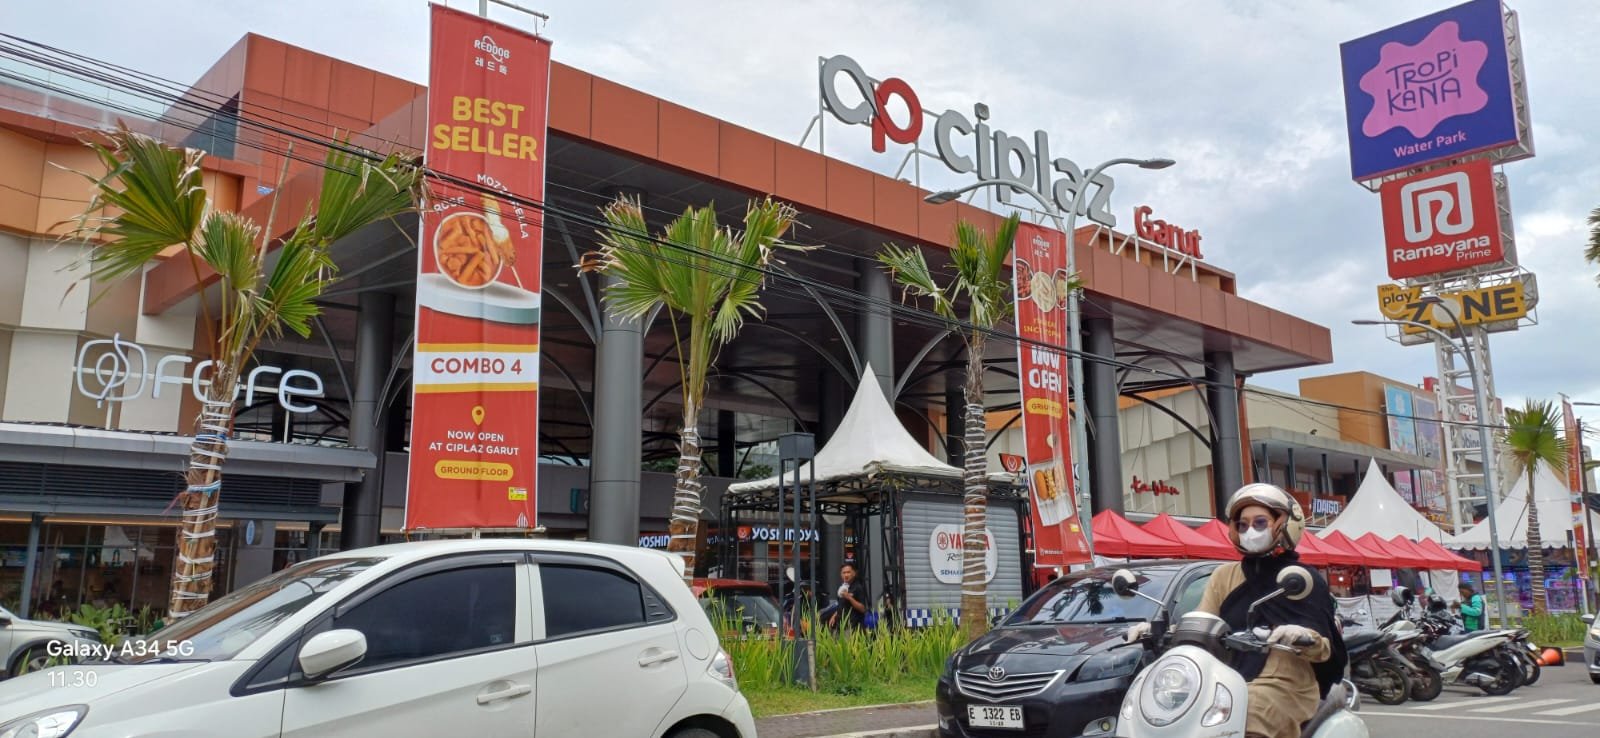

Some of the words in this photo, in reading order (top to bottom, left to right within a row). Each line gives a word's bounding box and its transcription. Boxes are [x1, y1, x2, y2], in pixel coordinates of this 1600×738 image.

[452, 96, 525, 129] BEST
[432, 123, 538, 161] SELLER
[1394, 137, 1433, 159] Water
[1436, 130, 1467, 149] Park
[934, 102, 1116, 228] ciplaz
[1135, 205, 1203, 260] Garut
[1393, 234, 1491, 264] Ramayana
[1456, 248, 1492, 262] Prime
[1382, 290, 1413, 307] play
[431, 358, 505, 375] COMBO
[511, 359, 522, 375] 4
[1028, 367, 1062, 393] OPEN
[447, 430, 475, 441] NOW
[478, 433, 504, 443] OPEN
[429, 442, 442, 451] AT
[446, 443, 484, 454] CIPLAZ
[486, 445, 519, 456] GARUT
[440, 466, 479, 476] GROUND
[480, 467, 509, 477] FLOOR
[969, 708, 976, 719] E
[983, 707, 1005, 720] 1322
